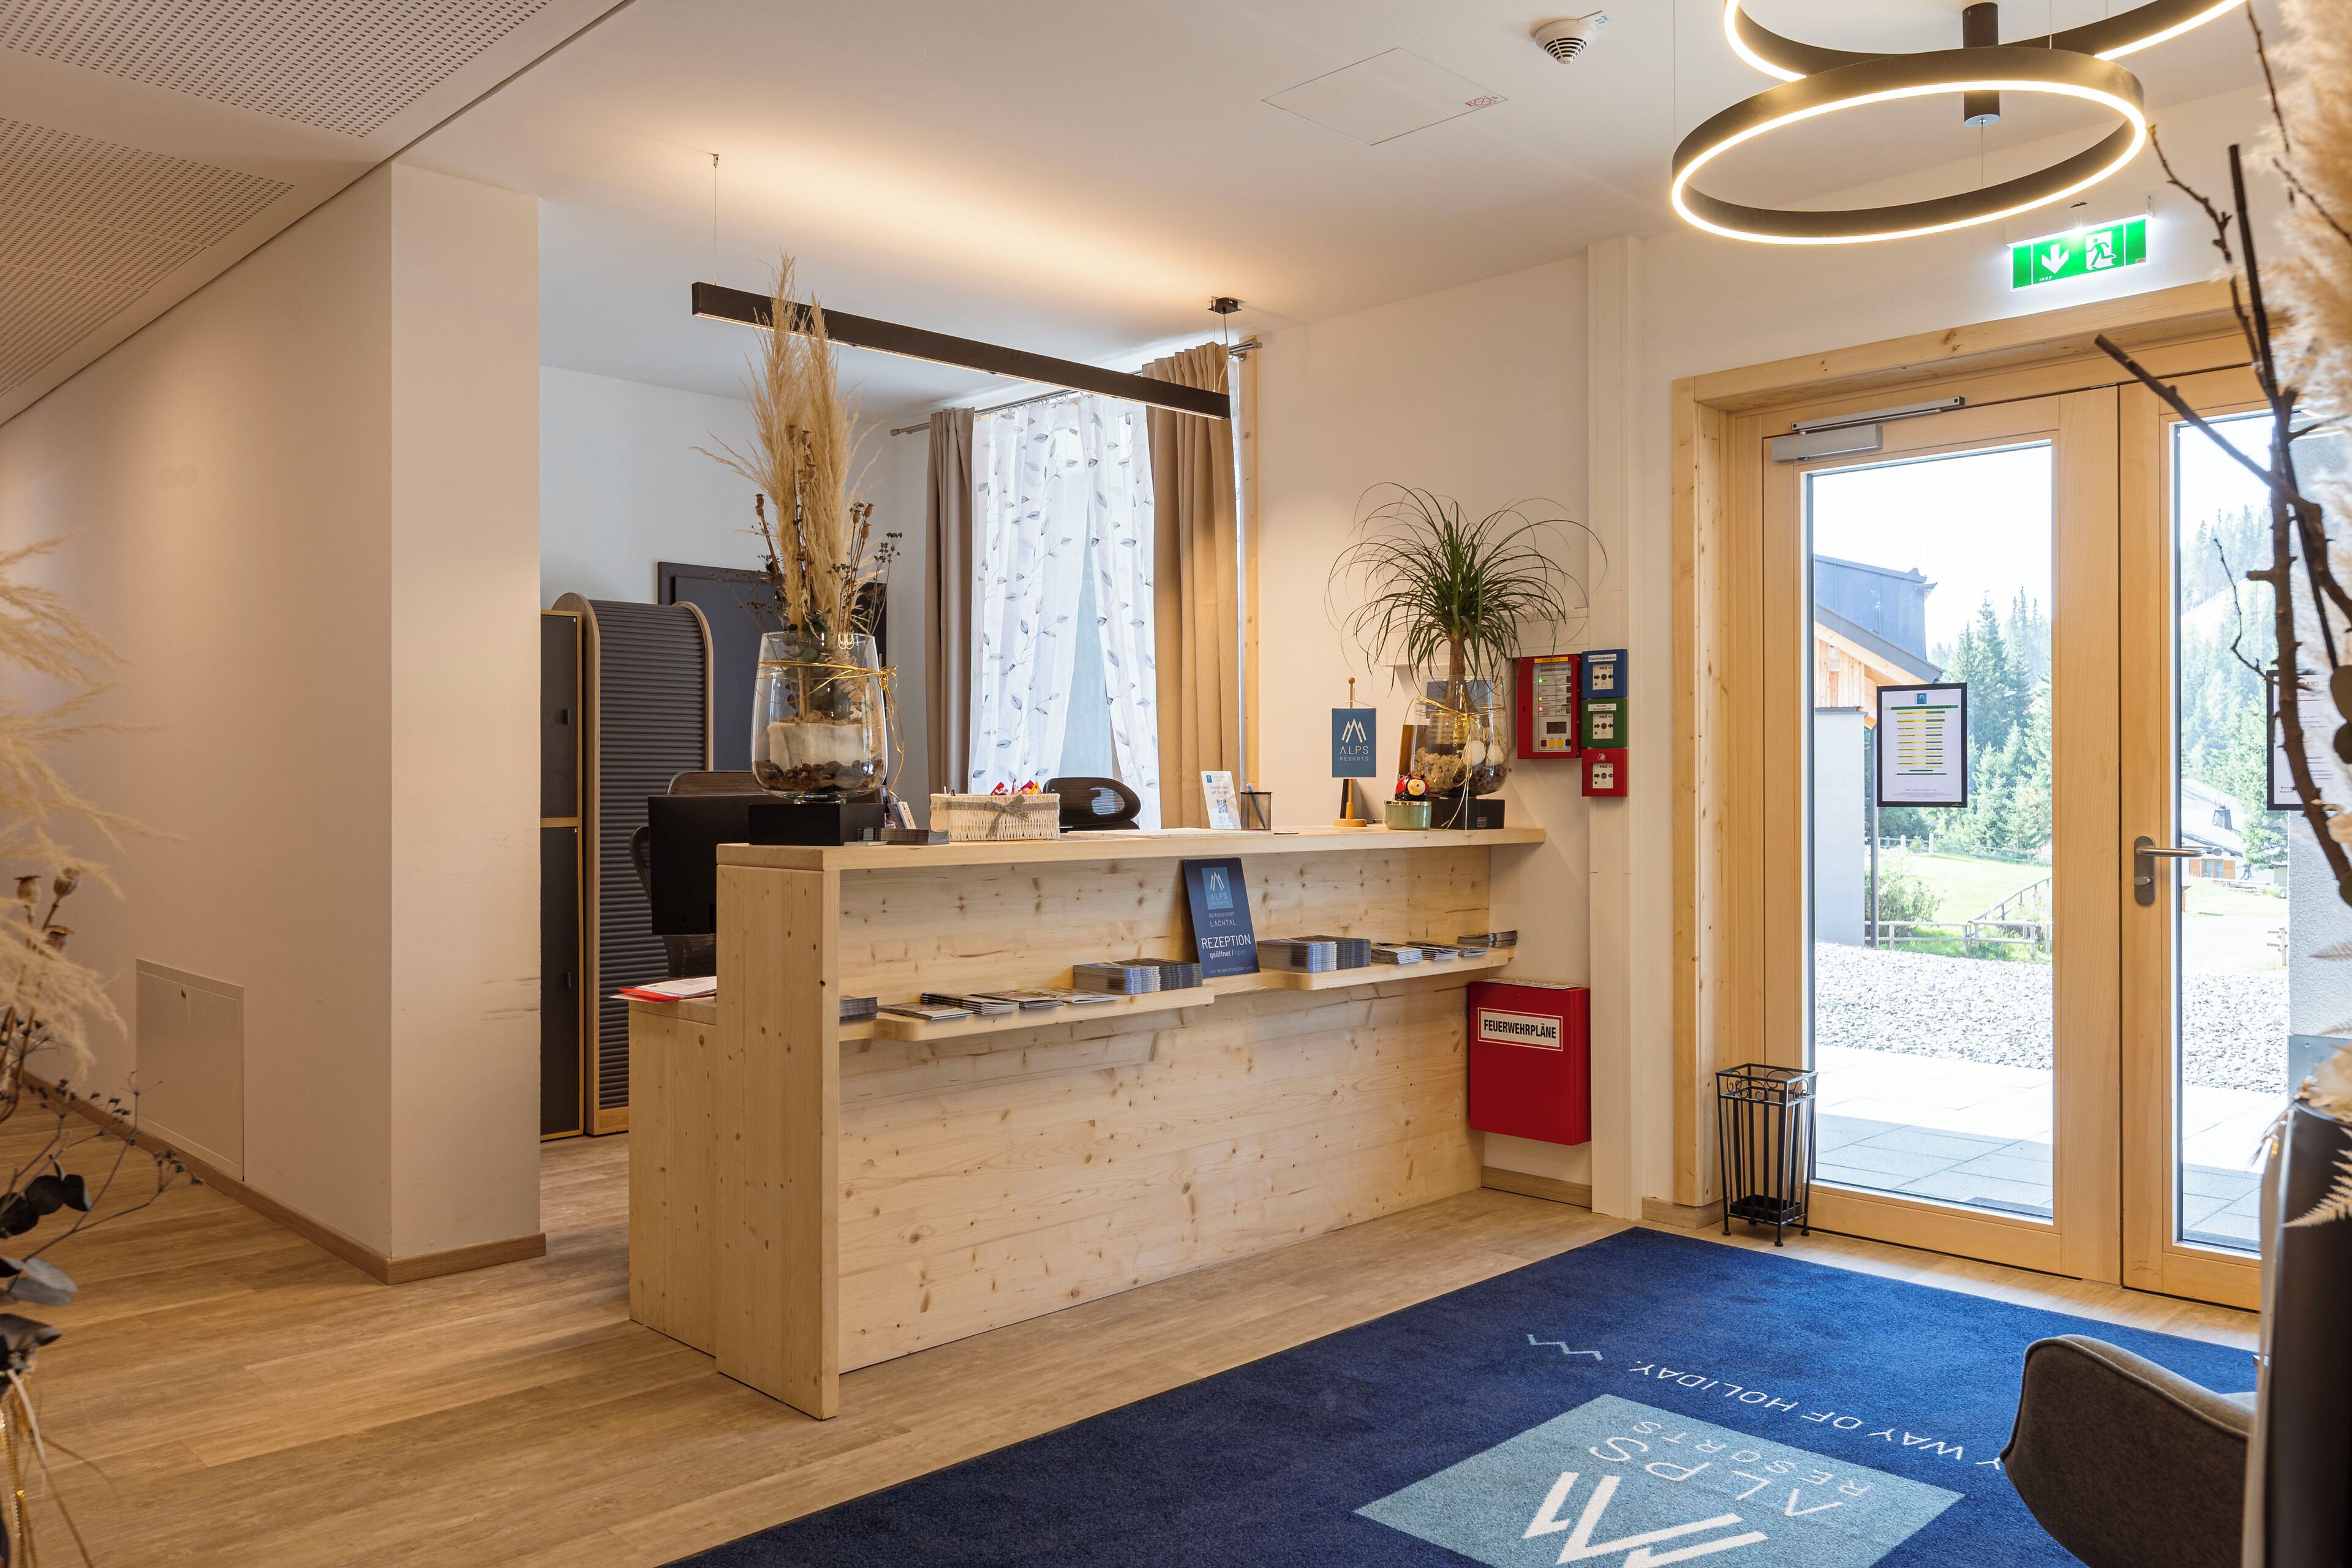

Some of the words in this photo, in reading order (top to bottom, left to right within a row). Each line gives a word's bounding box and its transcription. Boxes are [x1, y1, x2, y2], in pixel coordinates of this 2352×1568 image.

[1340, 745, 1369, 755] ALPS
[1210, 892, 1228, 900] ALPS
[1210, 919, 1237, 927] LACHTAL
[1200, 934, 1251, 949] REZEPTION
[1209, 950, 1231, 960] geöffnet
[1483, 1019, 1556, 1039] FEUERWEHRPLÄNE
[1801, 1411, 1863, 1430] OF
[1867, 1428, 1964, 1460] WAY
[1632, 1420, 1871, 1497] RESORTS
[1975, 1457, 2001, 1471] Y
[1589, 1436, 1844, 1517] ALPS
